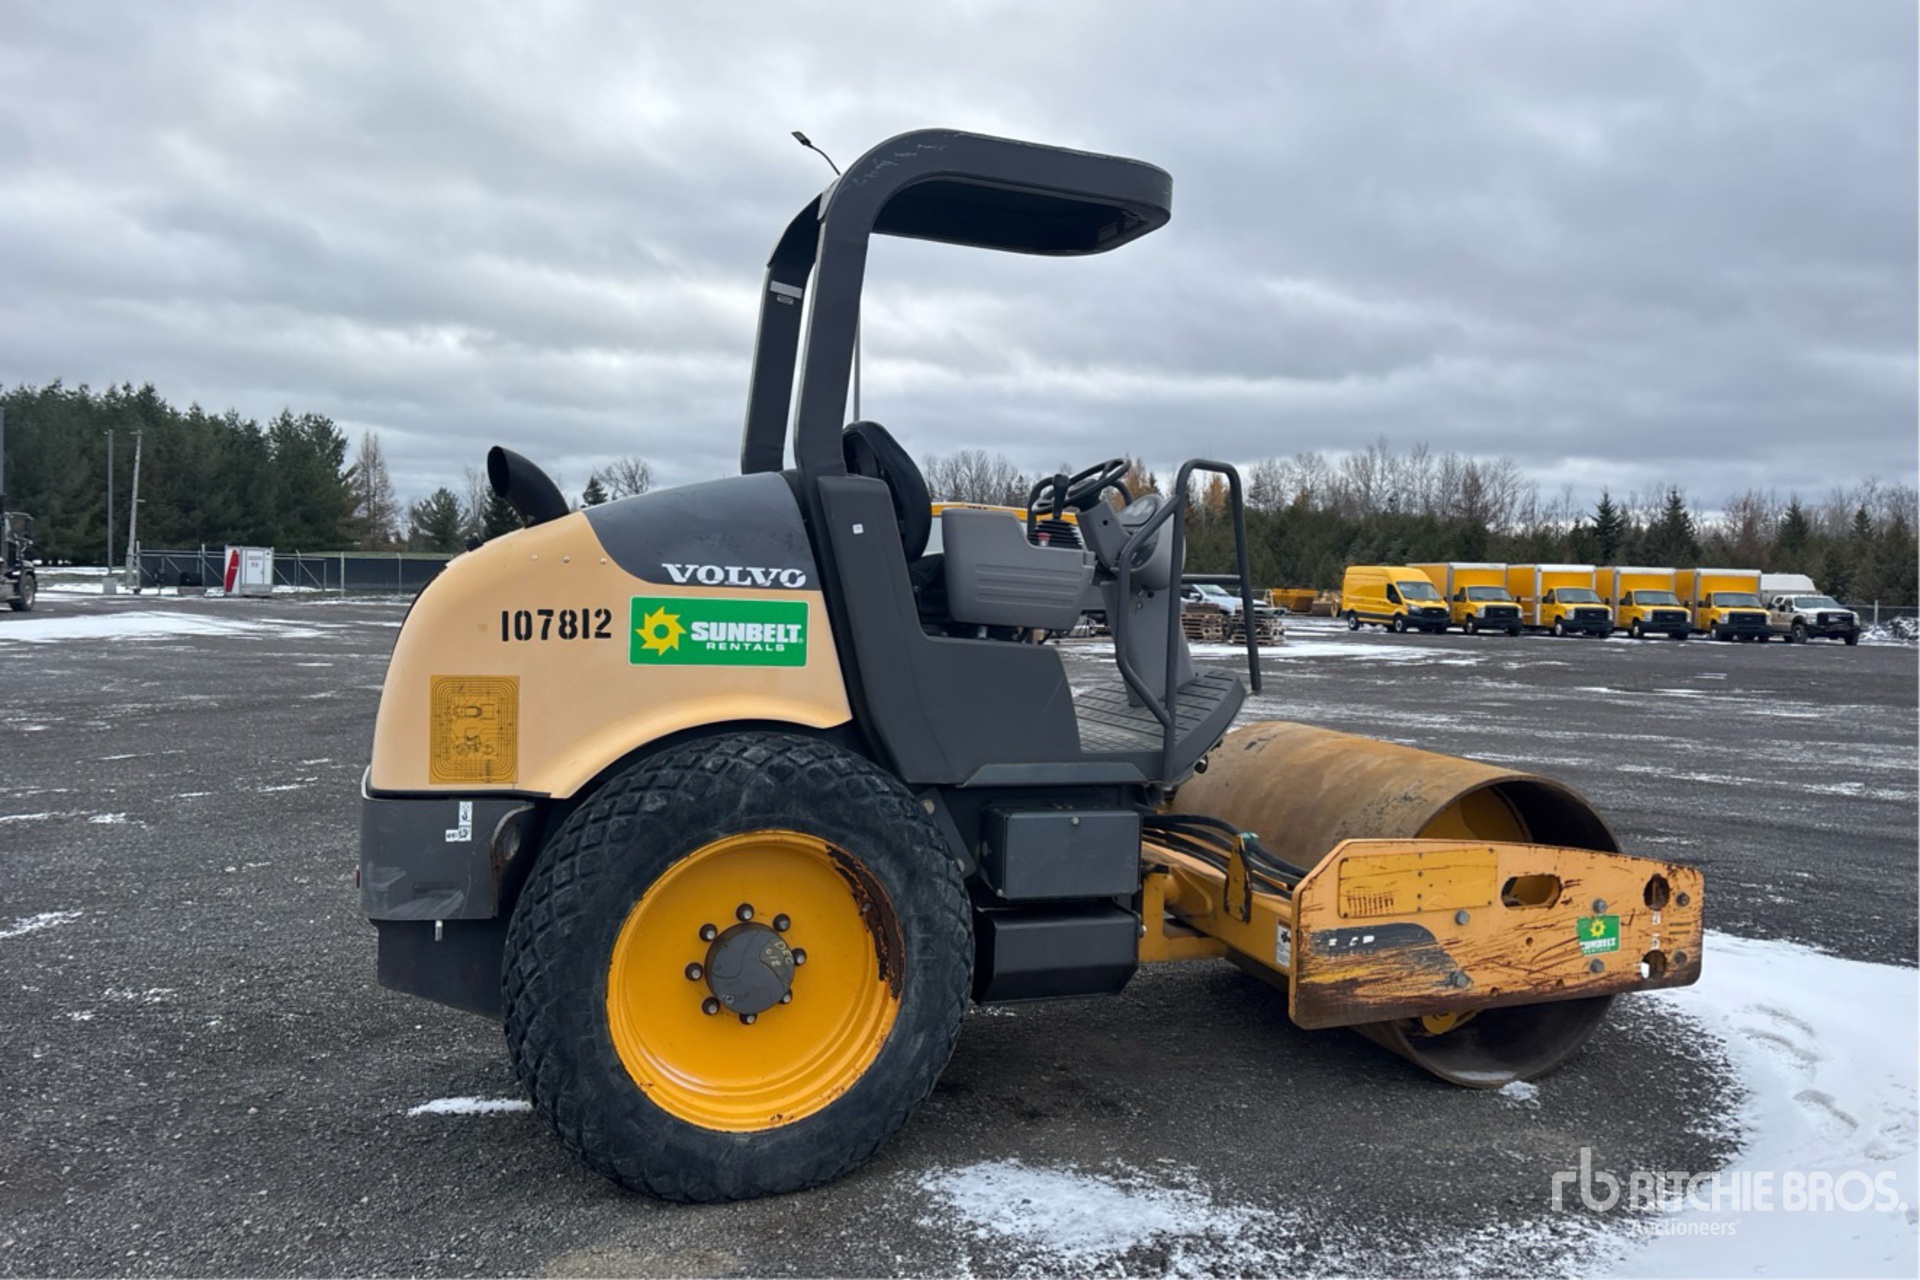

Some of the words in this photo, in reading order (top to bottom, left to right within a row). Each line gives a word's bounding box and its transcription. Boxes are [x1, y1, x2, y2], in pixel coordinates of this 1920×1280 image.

[662, 563, 807, 588] VOLVO
[501, 608, 613, 642] 107812
[691, 621, 802, 643] SUNBELT
[706, 642, 785, 652] RENTALS
